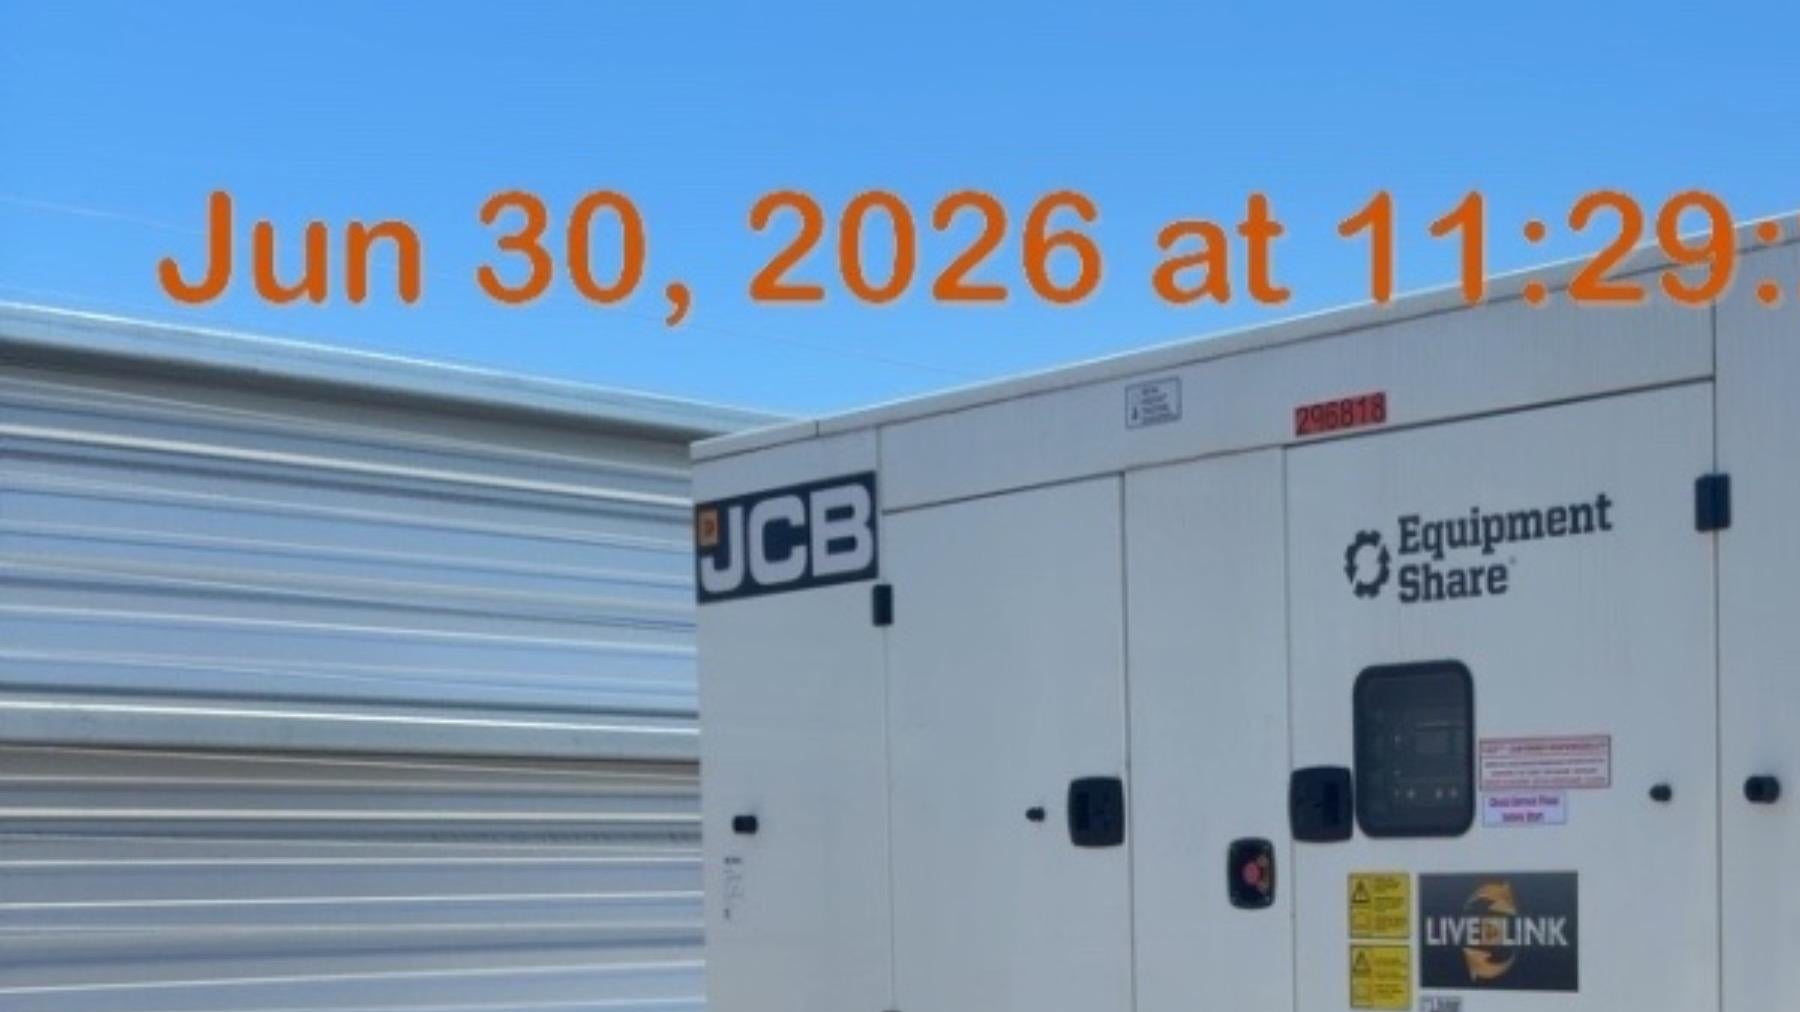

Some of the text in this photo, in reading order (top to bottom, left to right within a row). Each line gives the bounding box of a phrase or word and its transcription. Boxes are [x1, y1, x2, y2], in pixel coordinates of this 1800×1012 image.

[1296, 394, 1386, 434] 296818
[701, 483, 875, 593] JCB
[1399, 493, 1612, 561] Equipment
[1399, 560, 1507, 602] Share
